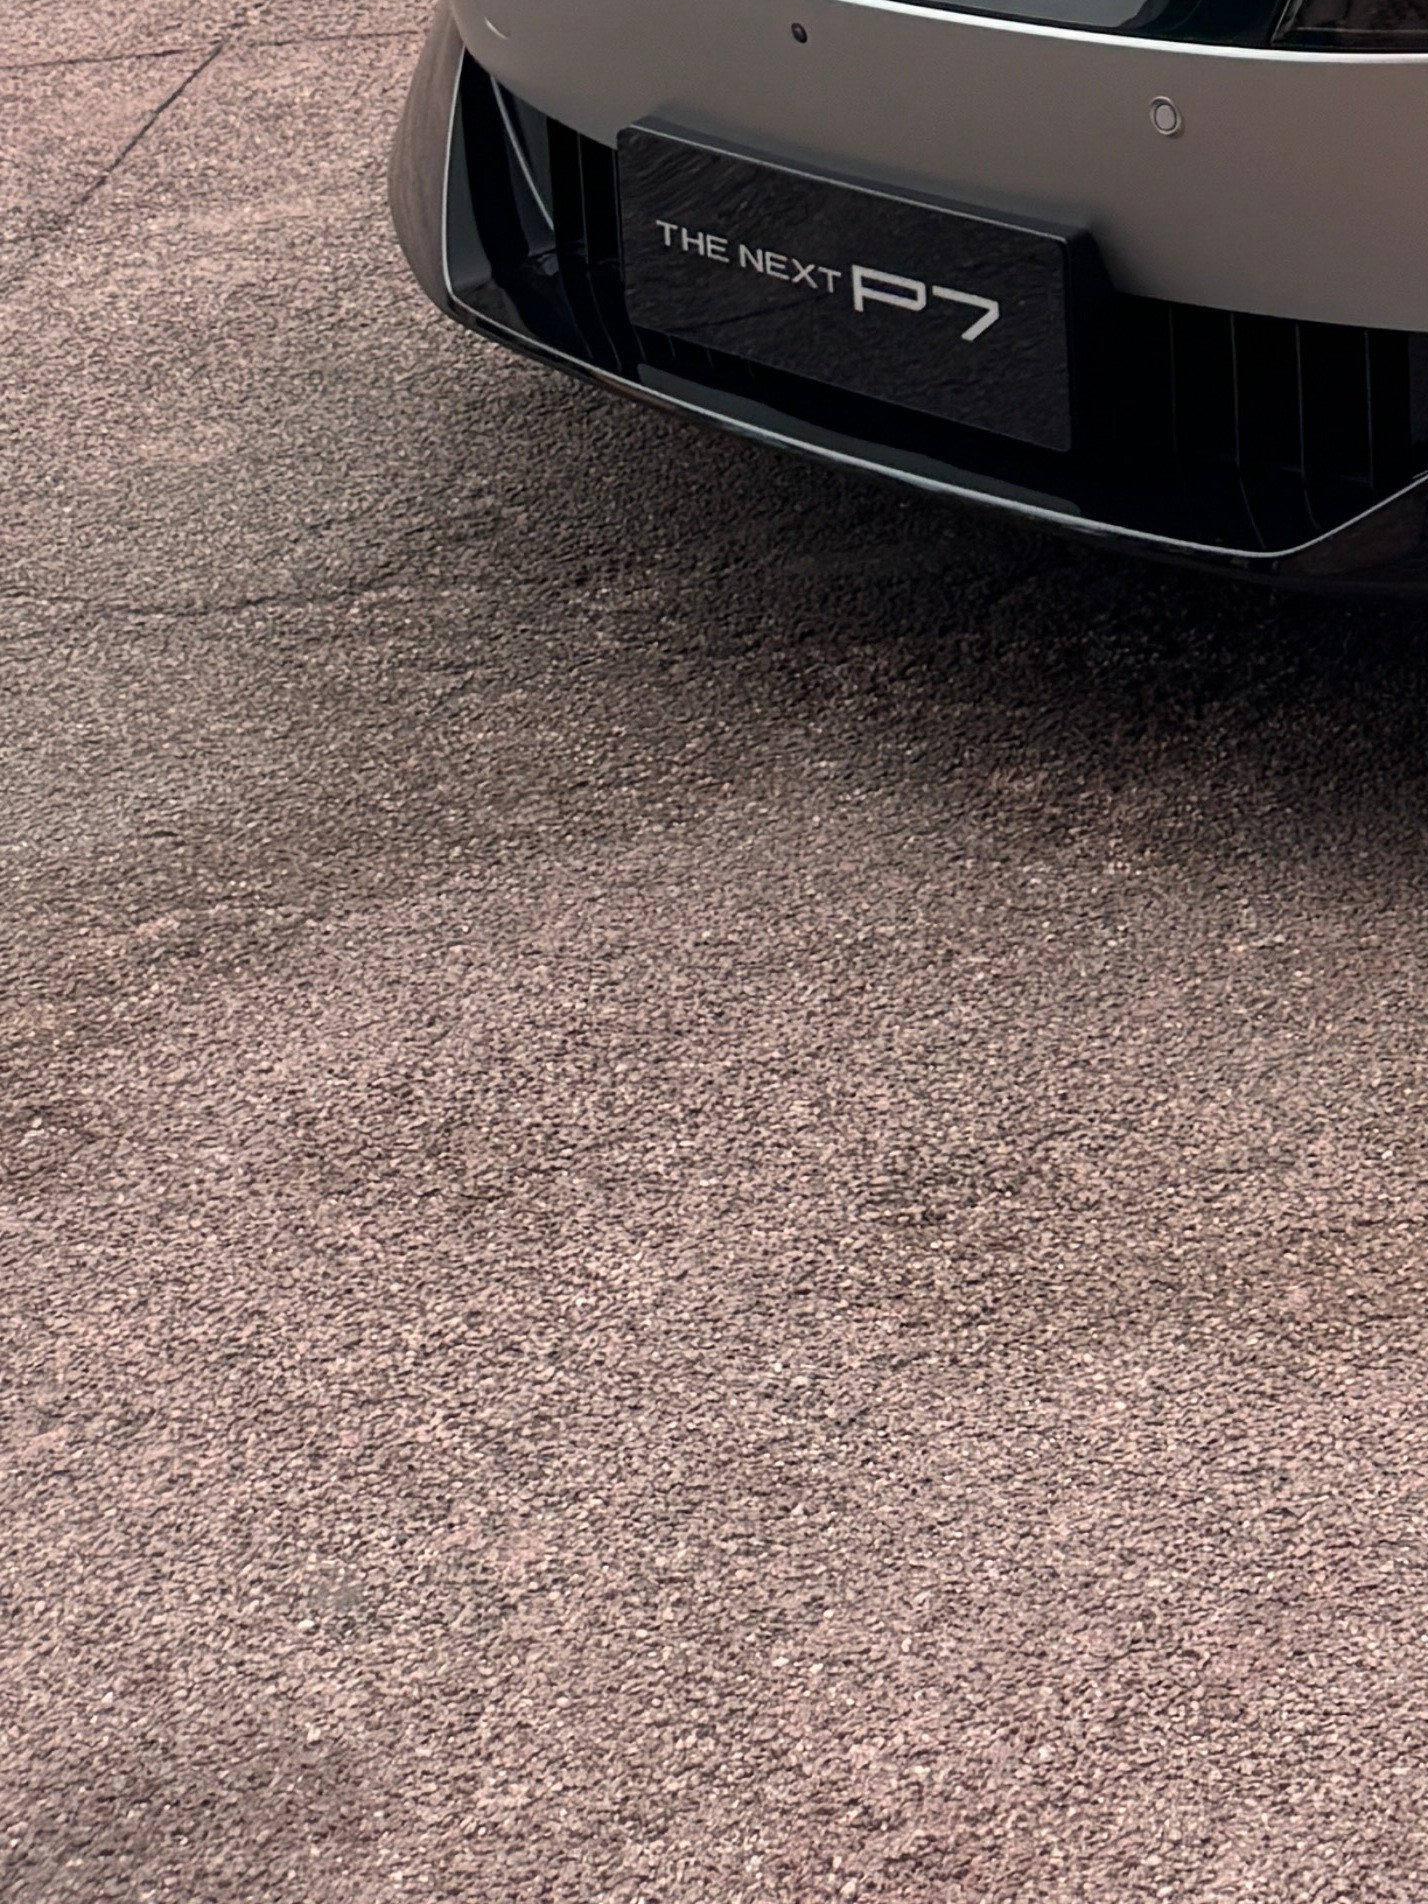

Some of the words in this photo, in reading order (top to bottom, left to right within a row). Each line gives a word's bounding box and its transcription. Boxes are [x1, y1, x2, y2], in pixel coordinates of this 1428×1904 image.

[656, 219, 729, 263] THE
[739, 244, 842, 293] NEXT
[851, 264, 1000, 341] P7
